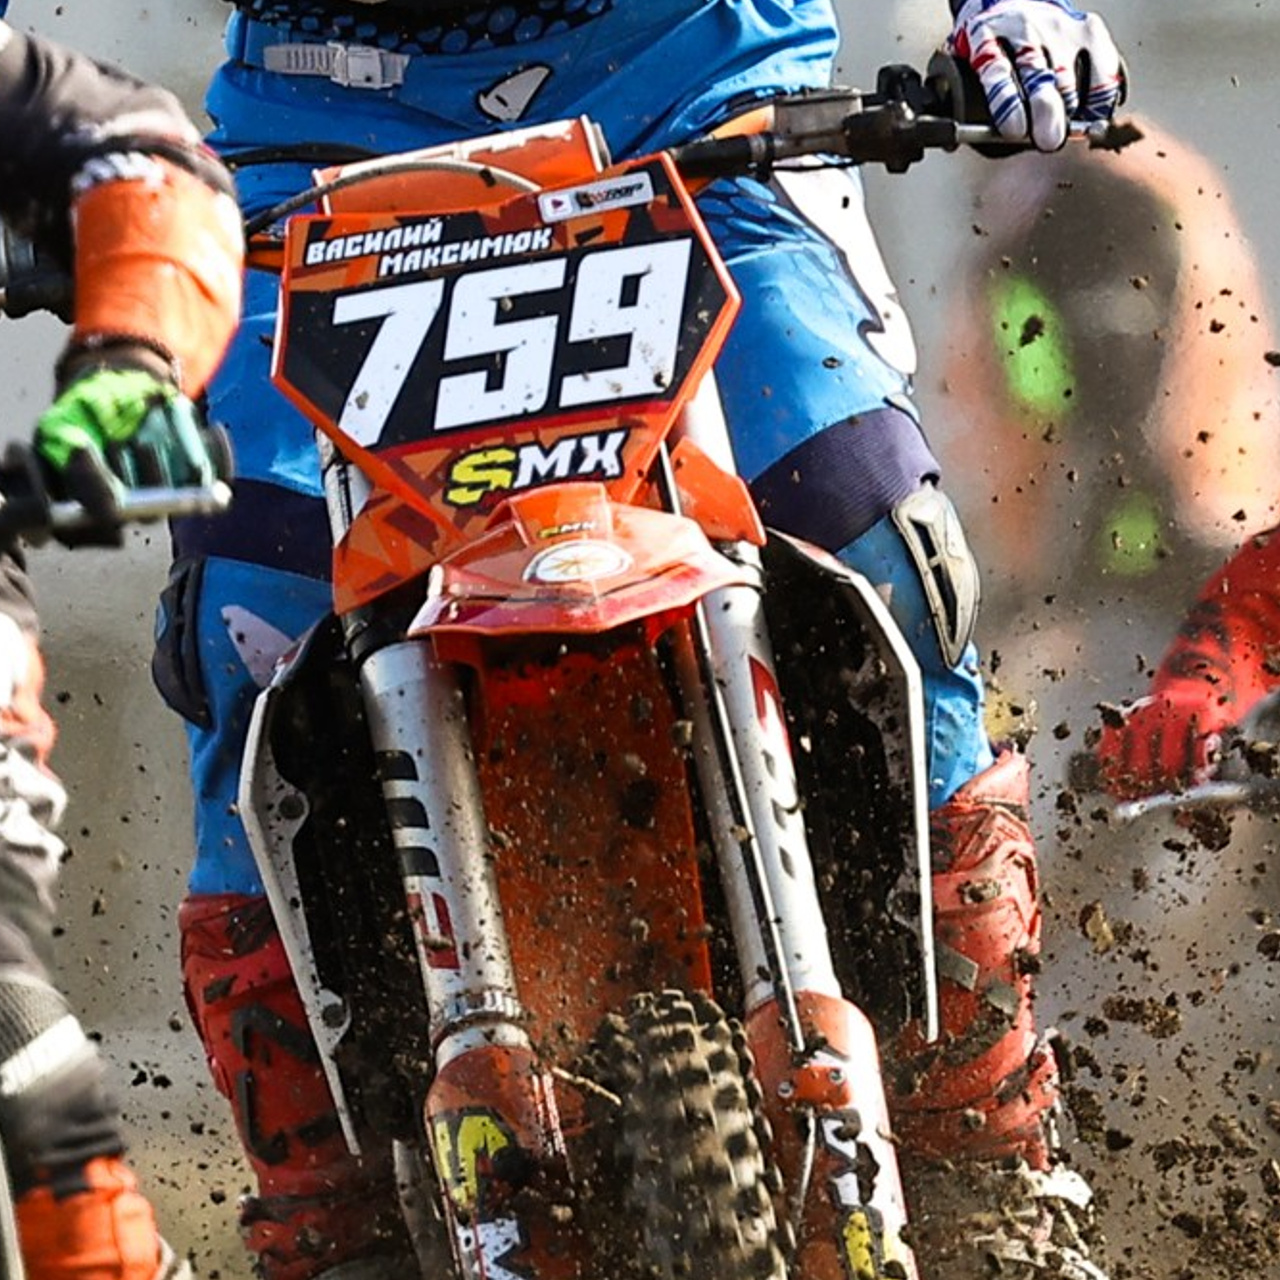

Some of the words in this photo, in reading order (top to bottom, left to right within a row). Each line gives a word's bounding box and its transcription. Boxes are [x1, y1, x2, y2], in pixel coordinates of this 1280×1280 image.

[306, 219, 443, 266] ВАСИЛИЙ
[379, 227, 552, 277] МАКСИМЮК
[332, 238, 693, 449] 759
[445, 431, 626, 506] SMX
